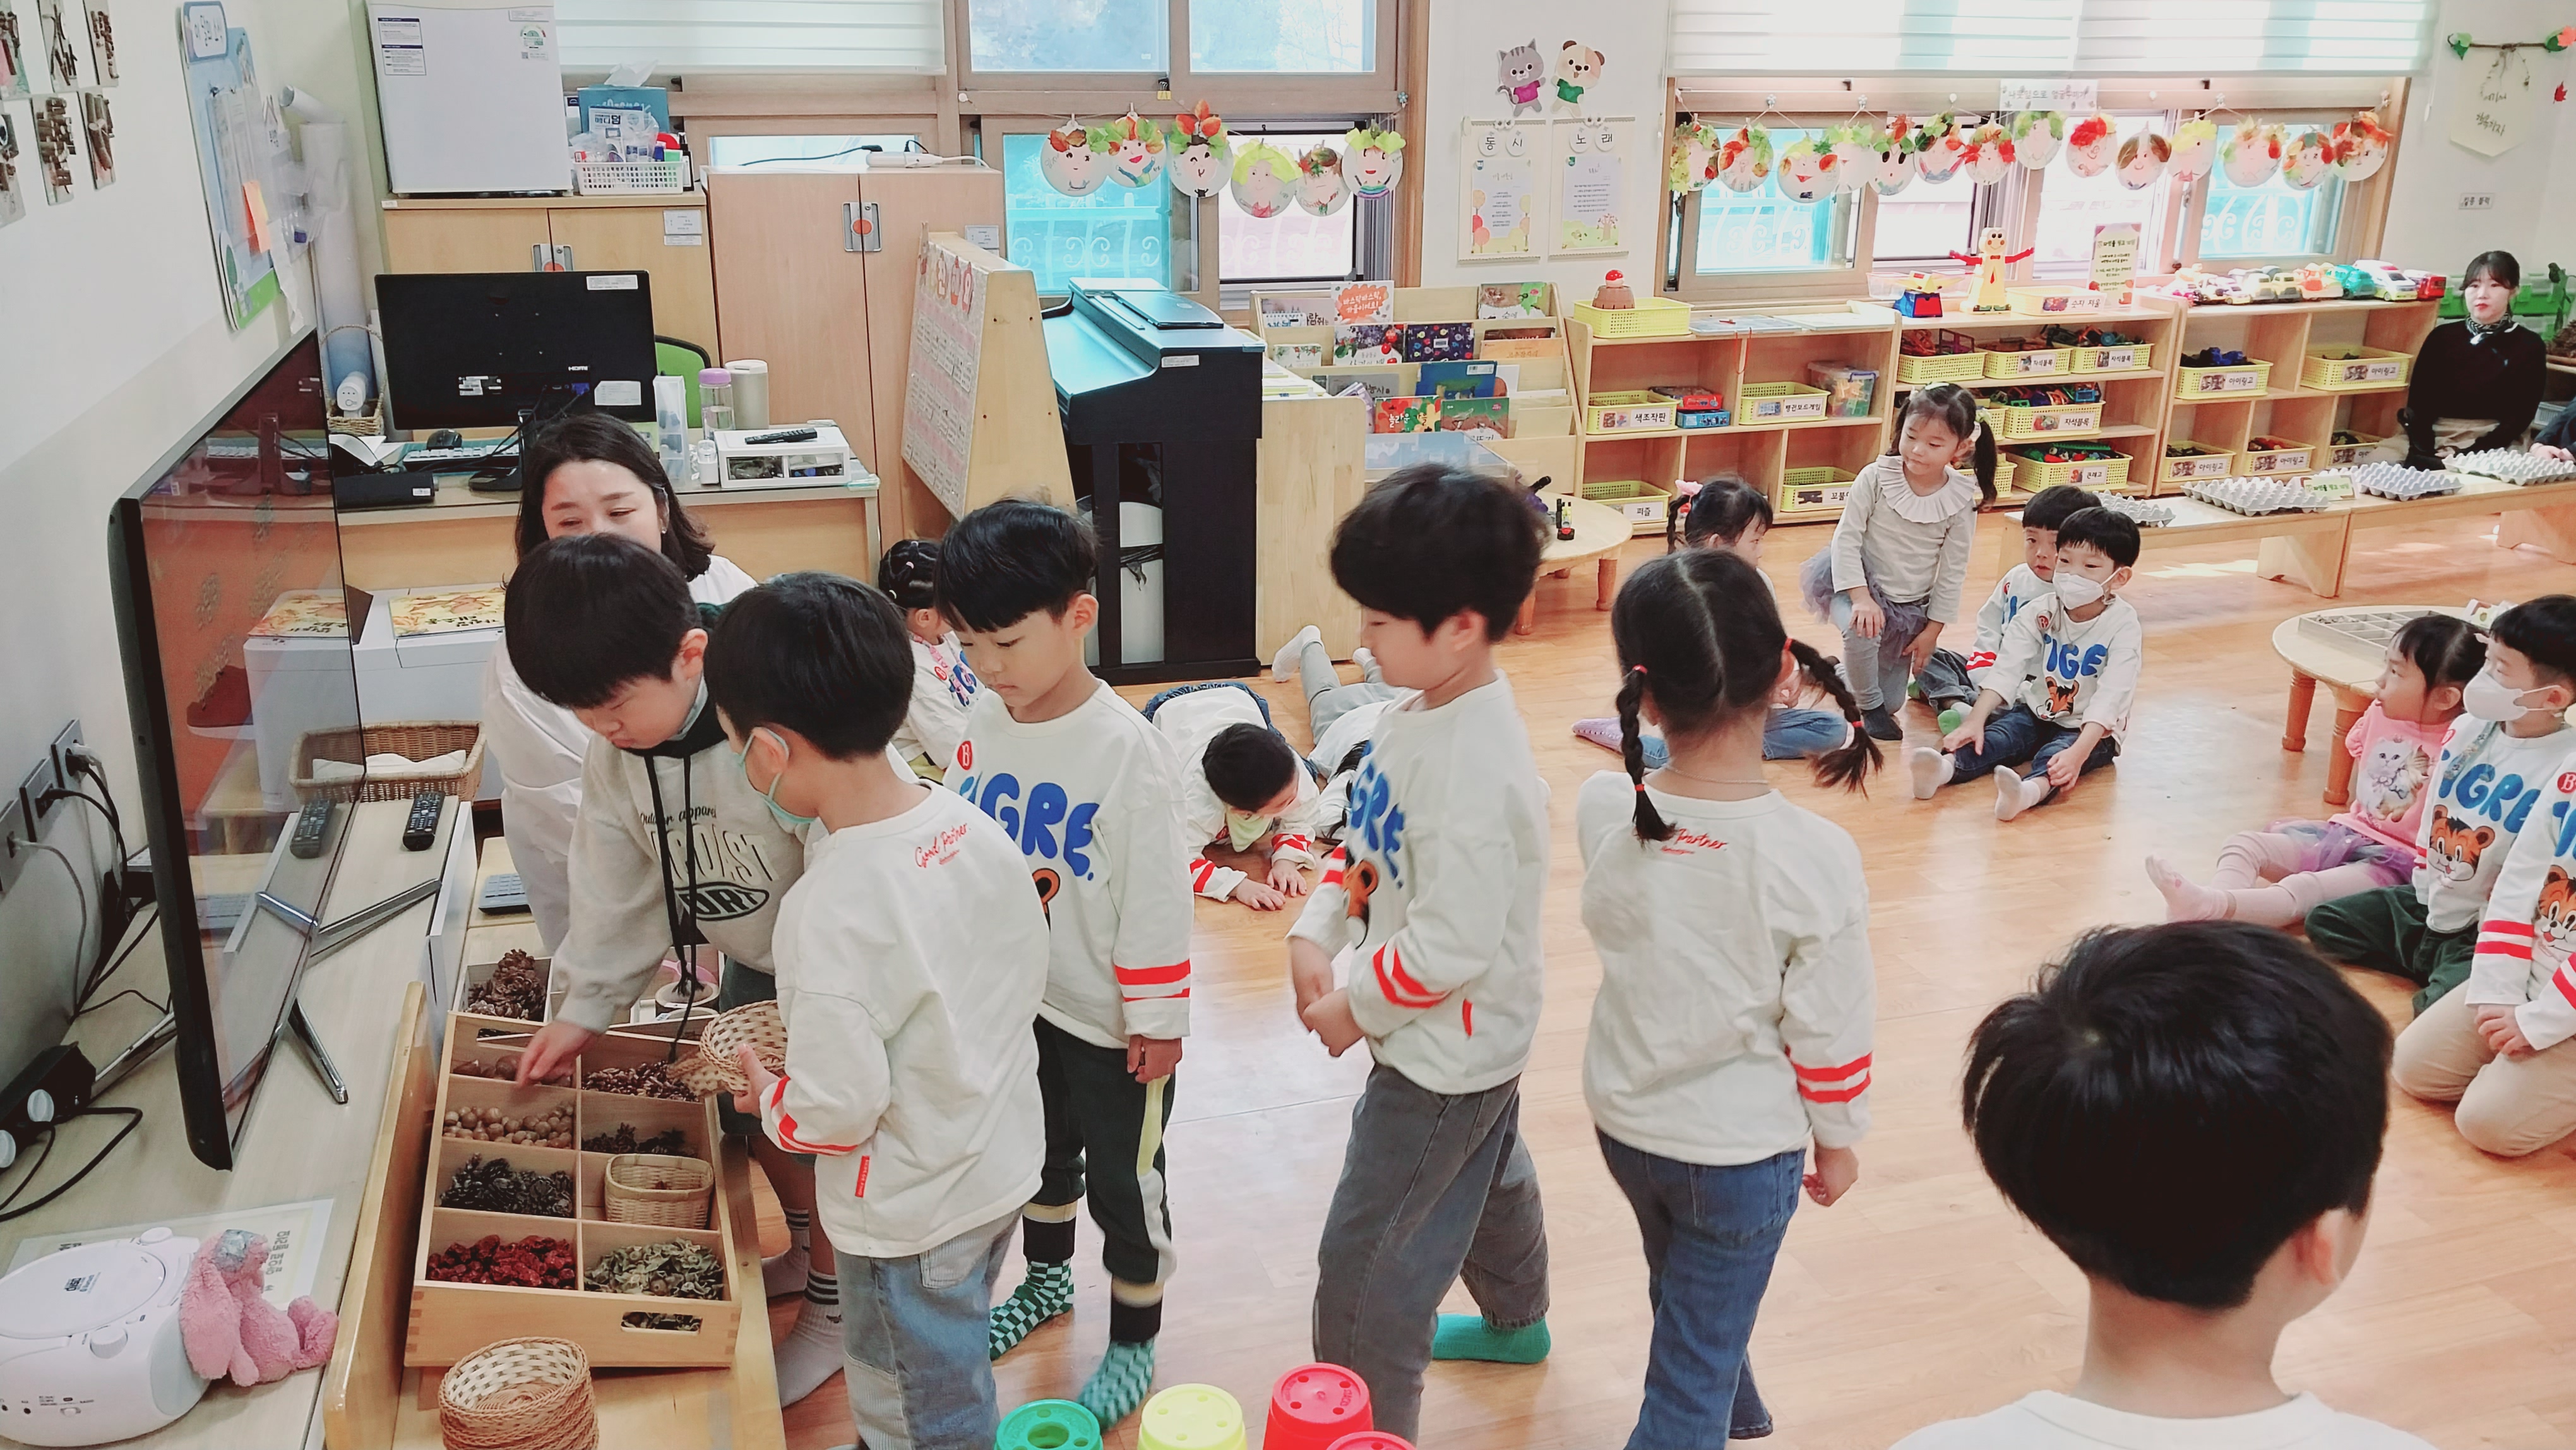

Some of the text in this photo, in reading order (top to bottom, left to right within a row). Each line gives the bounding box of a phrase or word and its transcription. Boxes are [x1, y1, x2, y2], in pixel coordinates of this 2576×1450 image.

[1485, 137, 1523, 151] 동 시
[1576, 133, 1613, 145] 노 래
[2371, 366, 2397, 376] 아이링고
[2228, 376, 2254, 386] 아이링고
[1389, 413, 1410, 428] 놀라운
[1635, 412, 1666, 423] 색조작판
[2064, 416, 2090, 426] 자석블록
[2280, 455, 2305, 465] 아이링고
[2198, 462, 2224, 472] 아이링고
[1636, 507, 1651, 516] 퍼즐
[961, 742, 971, 768] B
[915, 836, 940, 868] Good
